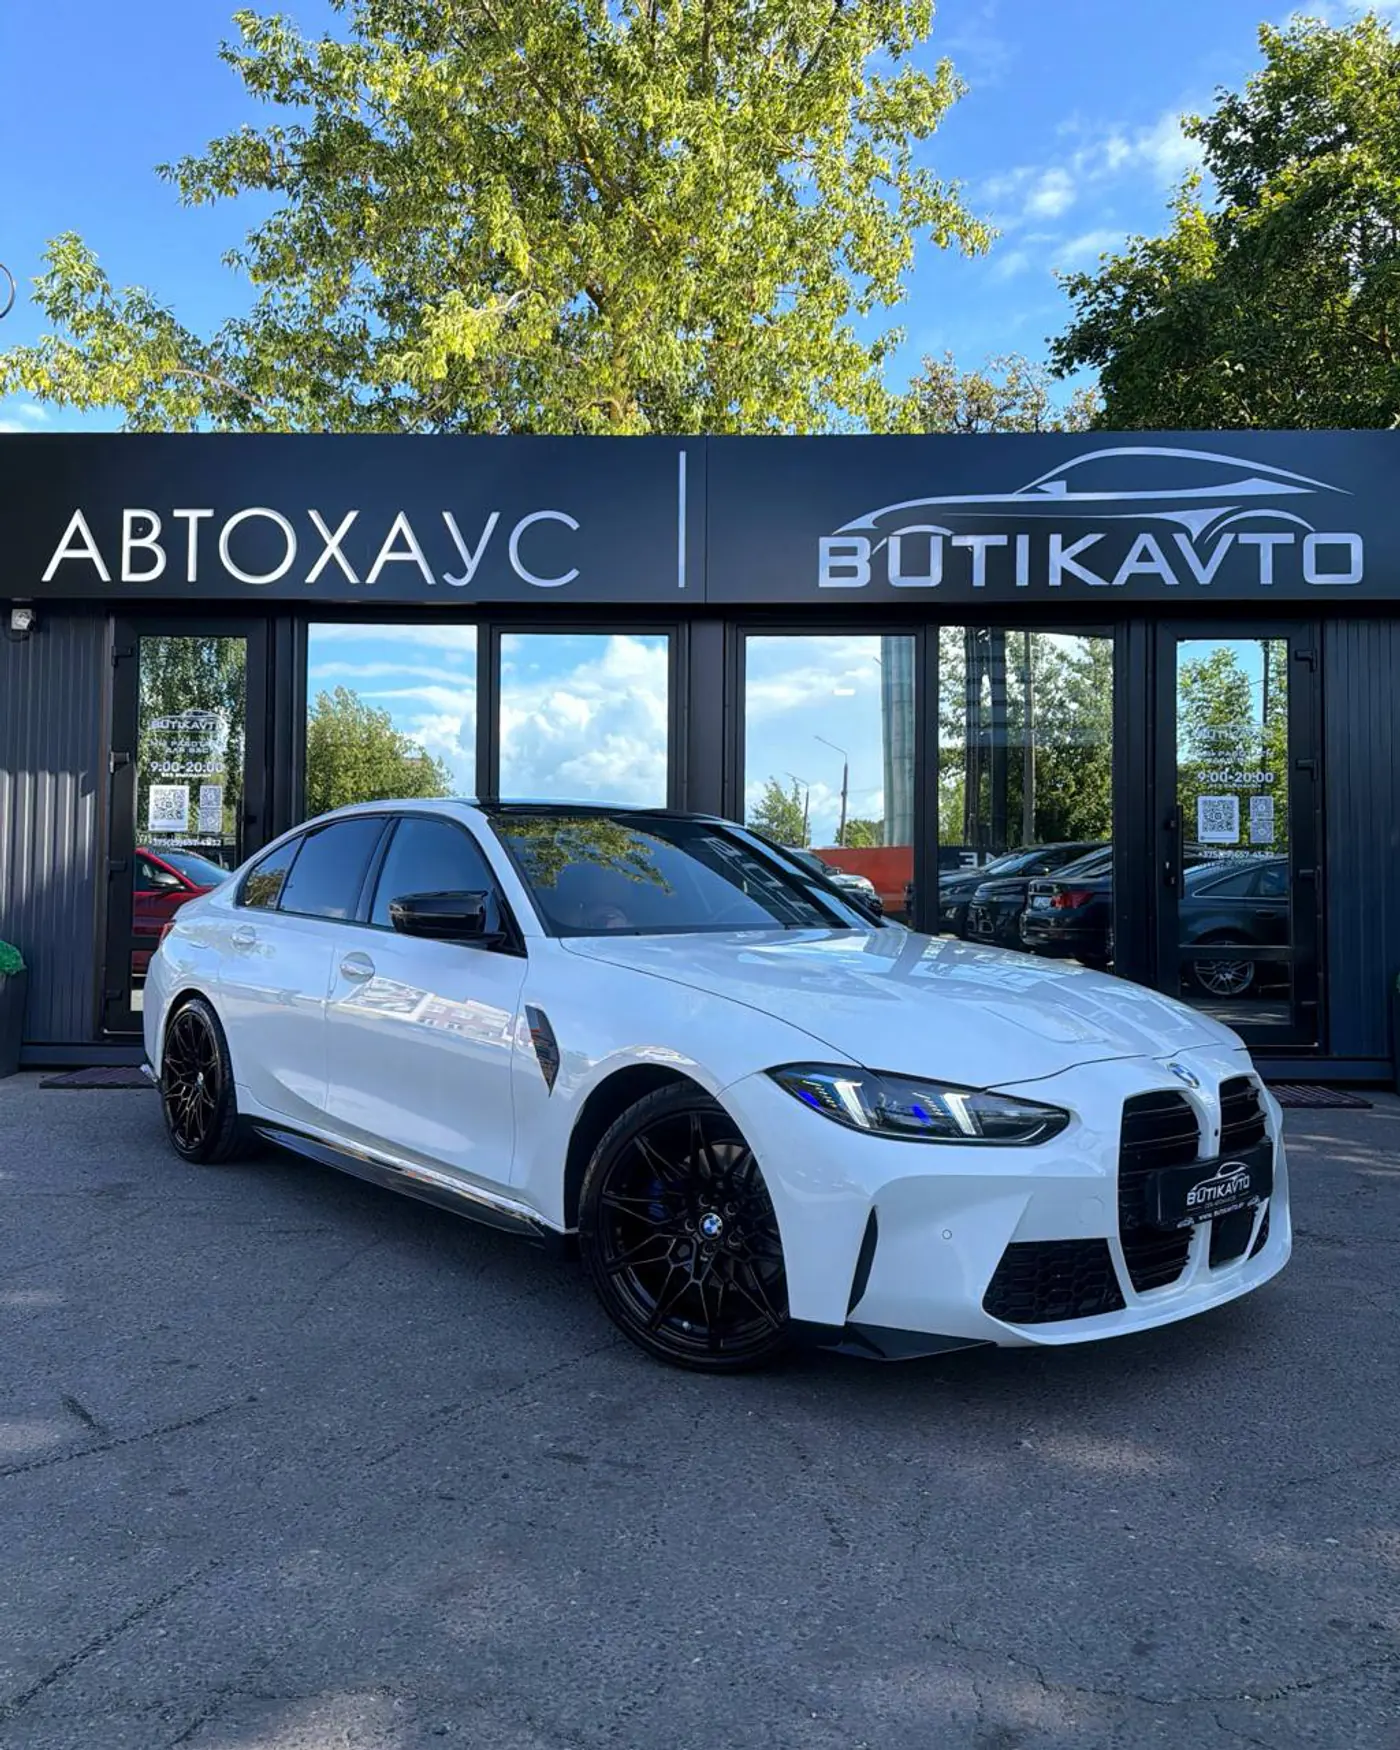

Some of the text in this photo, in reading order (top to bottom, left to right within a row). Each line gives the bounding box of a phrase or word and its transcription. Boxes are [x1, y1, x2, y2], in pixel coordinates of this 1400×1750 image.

[42, 507, 580, 588] АВТОХАУС
[818, 531, 1364, 588] BUTIKAVTO
[150, 761, 223, 773] 9:00-20:00
[1197, 772, 1275, 783] 9:00-20:00
[1186, 1175, 1250, 1206] BUTIKAVTO
